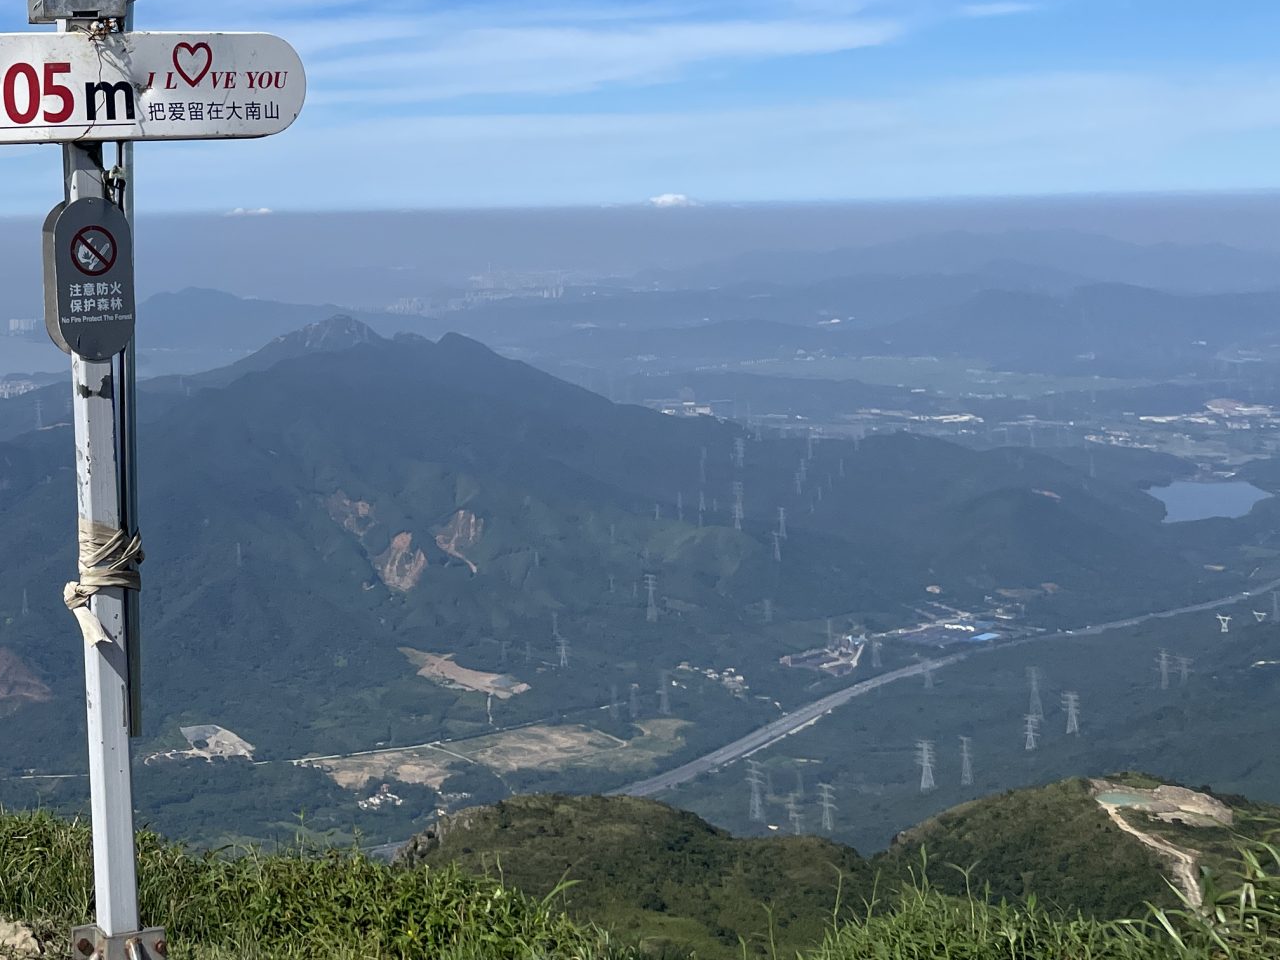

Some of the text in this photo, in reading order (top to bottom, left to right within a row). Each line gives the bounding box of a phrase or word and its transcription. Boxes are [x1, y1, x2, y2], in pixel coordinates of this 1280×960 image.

[146, 71, 157, 90] I
[245, 71, 289, 89] YOU
[148, 101, 280, 122] 把爱留在大南山
[69, 281, 122, 297] 注意防火
[70, 297, 123, 313] 保护森林
[114, 313, 133, 321] Forest
